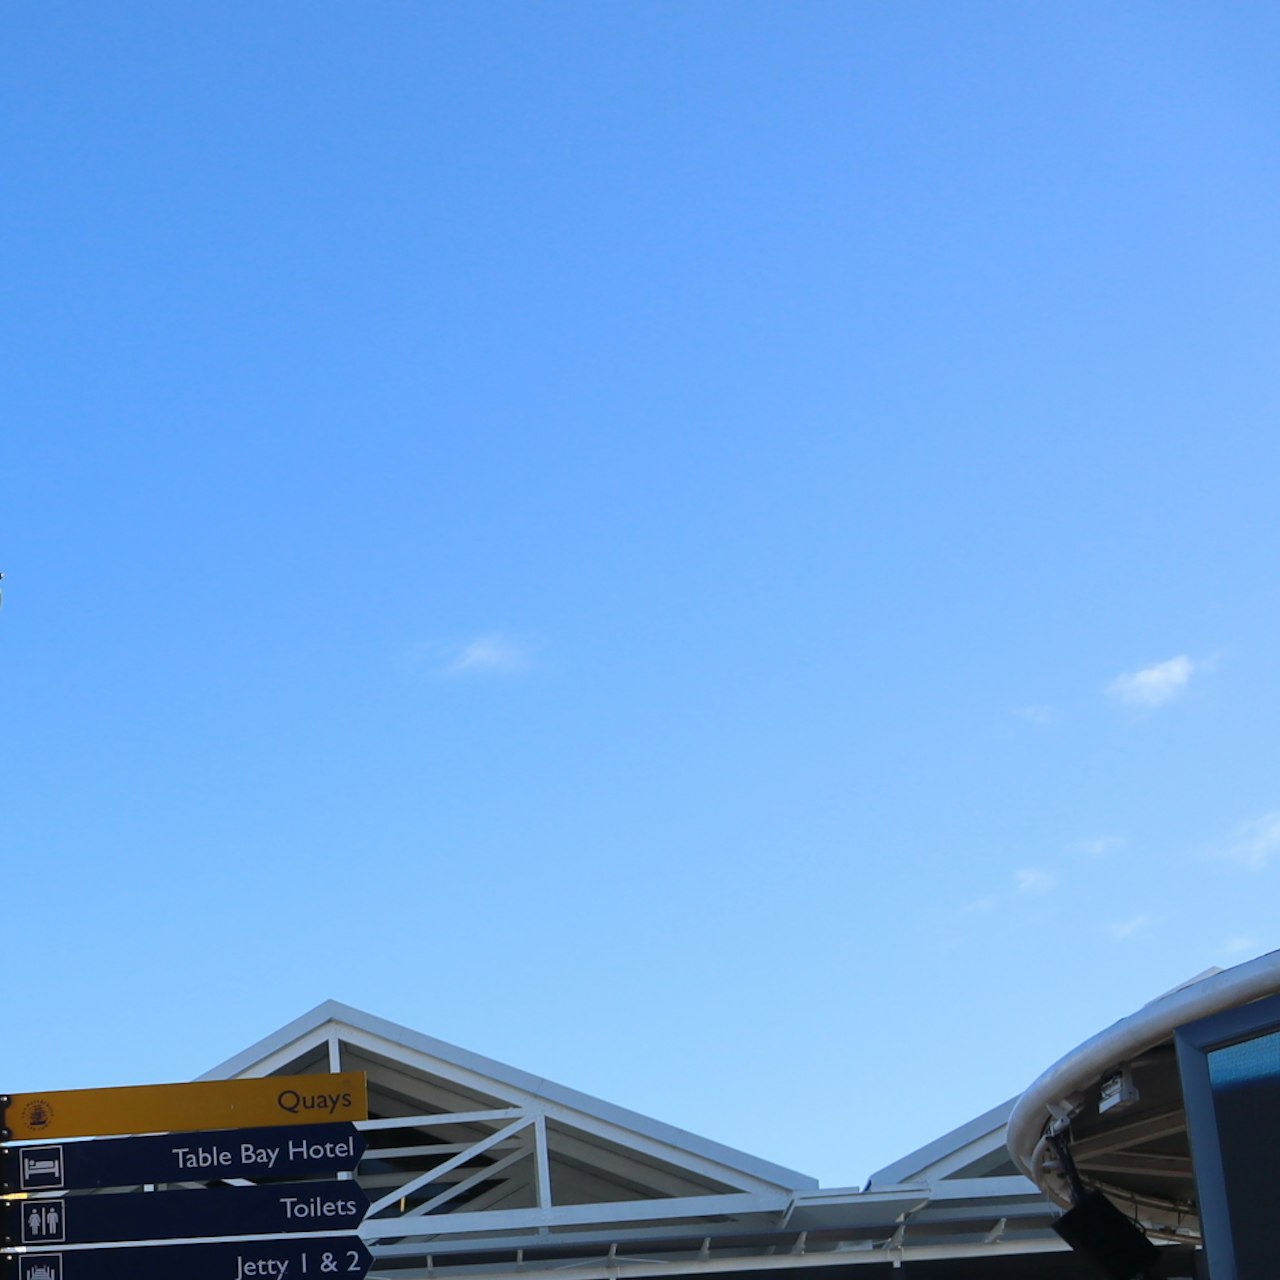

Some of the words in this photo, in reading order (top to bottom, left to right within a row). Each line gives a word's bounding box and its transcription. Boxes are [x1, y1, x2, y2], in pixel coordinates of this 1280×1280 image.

[277, 1088, 352, 1114] Quays
[172, 1145, 233, 1169] Table
[241, 1143, 280, 1170] Bay
[288, 1136, 355, 1161] Hotel
[280, 1196, 357, 1219] Toilets
[301, 1253, 308, 1273] 1
[320, 1252, 338, 1272] &
[346, 1251, 362, 1271] 2
